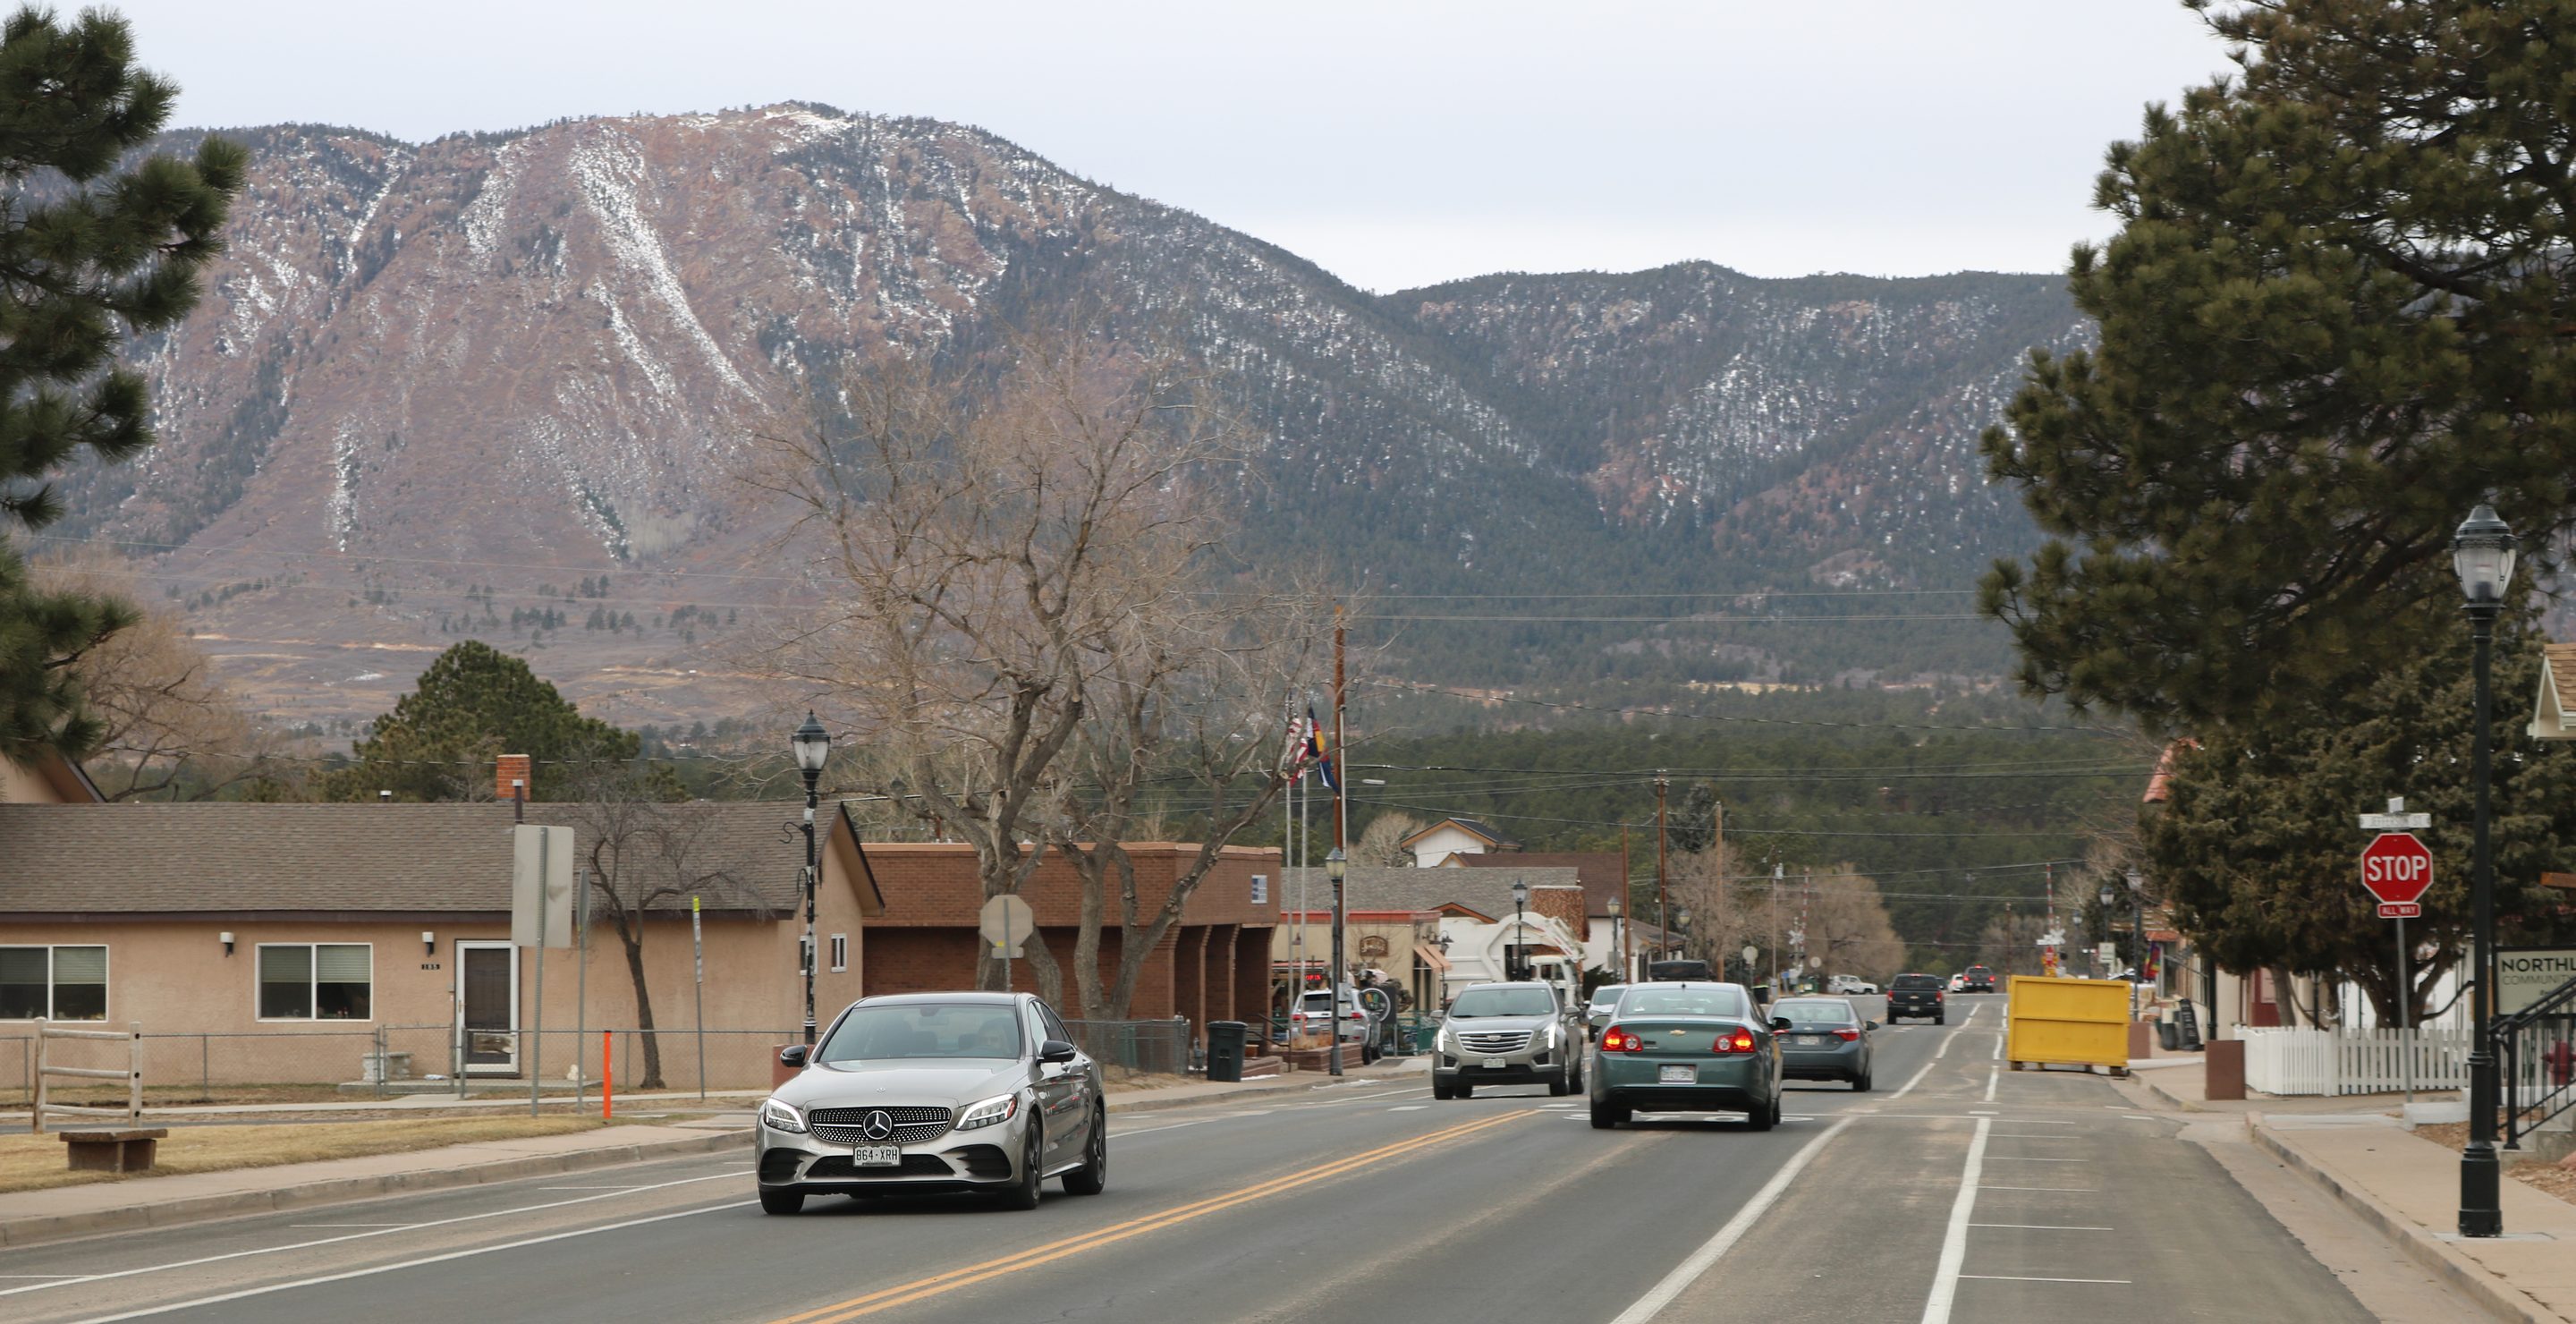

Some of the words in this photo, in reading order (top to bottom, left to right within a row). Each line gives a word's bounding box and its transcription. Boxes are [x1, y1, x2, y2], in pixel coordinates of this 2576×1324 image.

[2367, 855, 2428, 881] STOP
[2382, 906, 2396, 914] ALL
[2400, 906, 2416, 914] WAY
[2502, 957, 2576, 972] NORTHL
